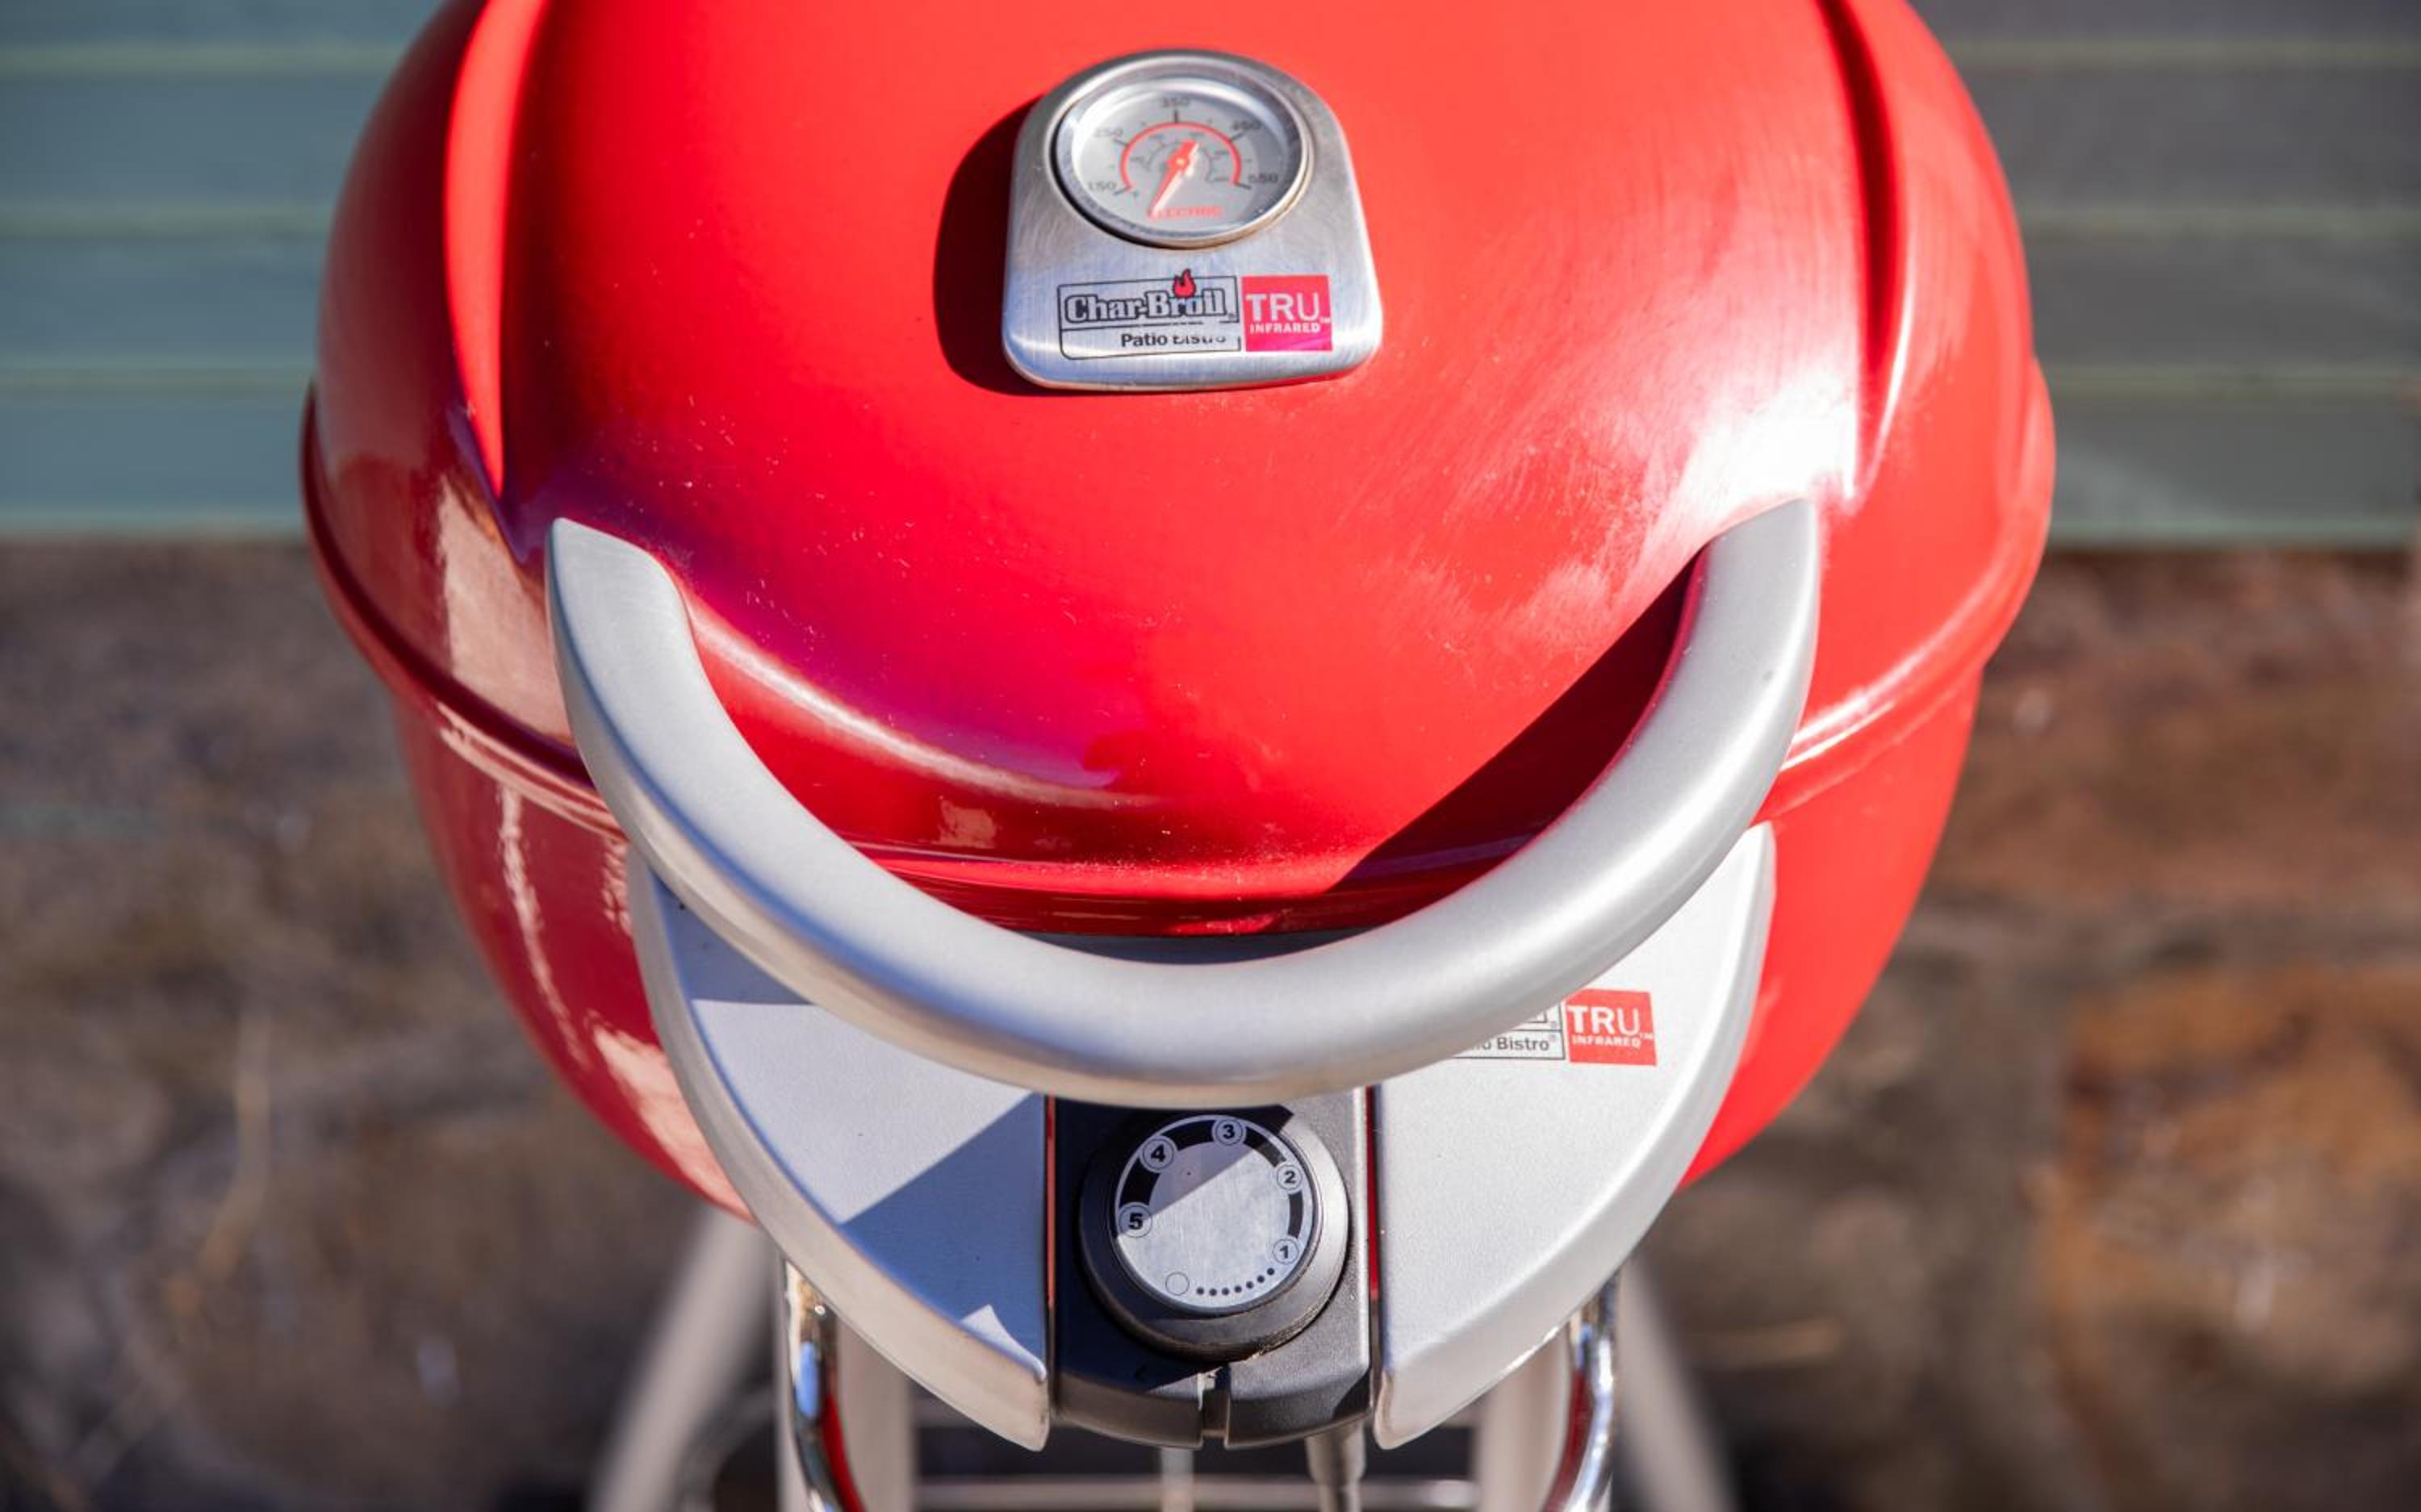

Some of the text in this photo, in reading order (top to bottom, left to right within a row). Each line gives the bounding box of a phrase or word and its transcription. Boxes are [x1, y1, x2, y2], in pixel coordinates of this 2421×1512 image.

[1065, 289, 1227, 323] Char-Broil
[1246, 292, 1321, 322] TRU
[1250, 322, 1321, 334] INFRARED
[1121, 332, 1168, 347] Patio
[1568, 1005, 1640, 1035] TRU
[1497, 1036, 1550, 1051] Bistro
[1223, 1124, 1236, 1139] 3
[1151, 1146, 1165, 1162] 4
[1285, 1170, 1296, 1184] 2
[1129, 1213, 1144, 1230] 5
[1280, 1245, 1289, 1259] 1
